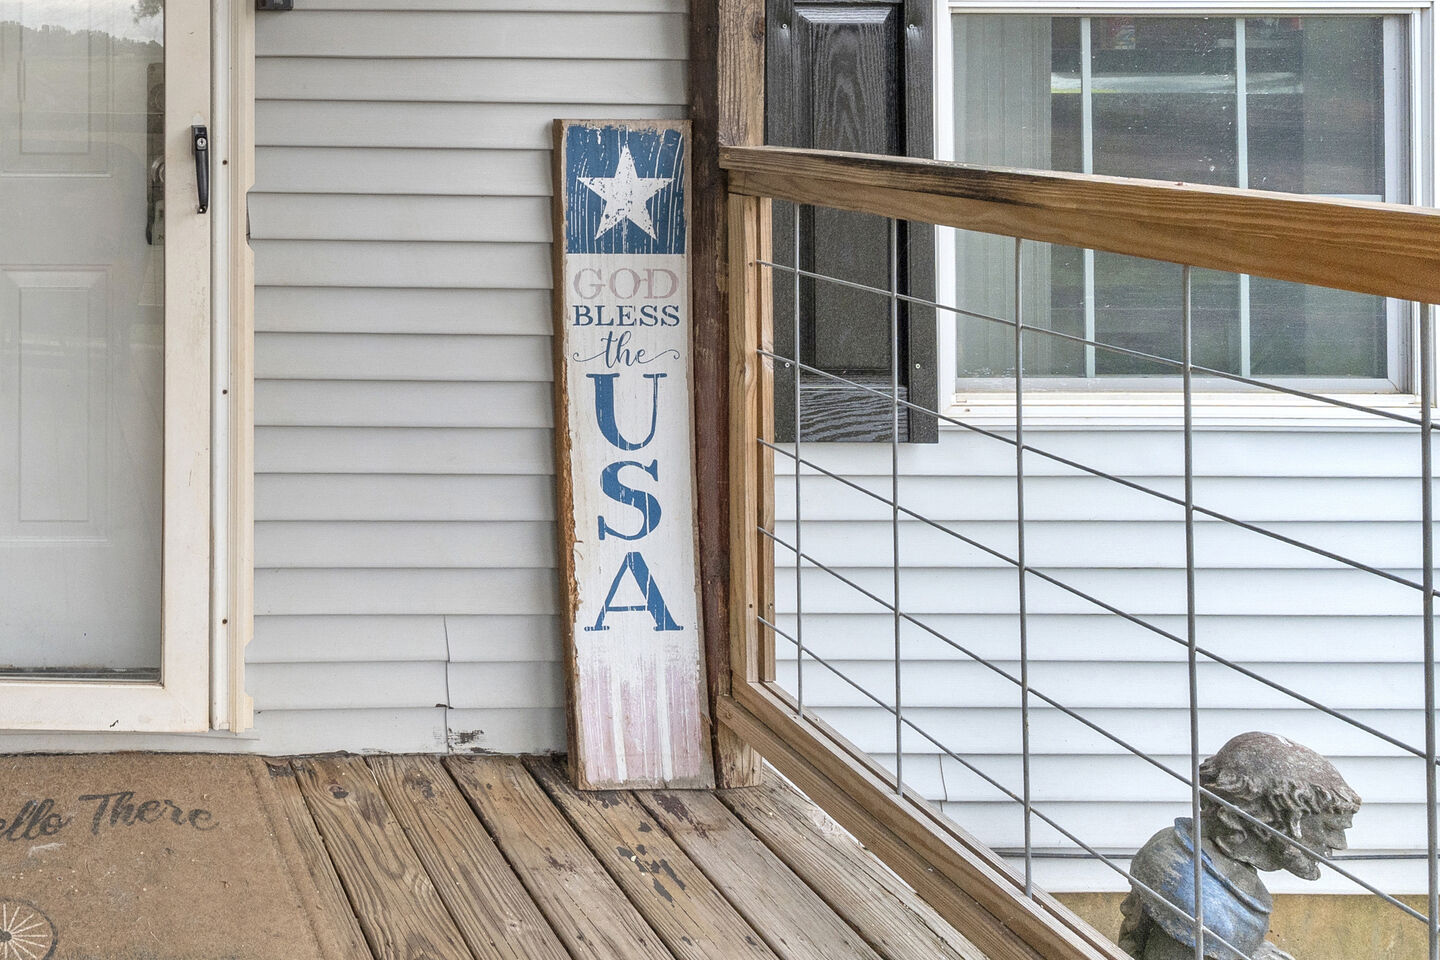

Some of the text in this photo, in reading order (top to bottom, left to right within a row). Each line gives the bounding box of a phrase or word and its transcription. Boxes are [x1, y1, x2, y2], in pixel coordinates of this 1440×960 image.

[572, 267, 680, 300] GOD
[572, 304, 680, 327] BLESS
[572, 330, 680, 369] the
[78, 791, 219, 835] There
